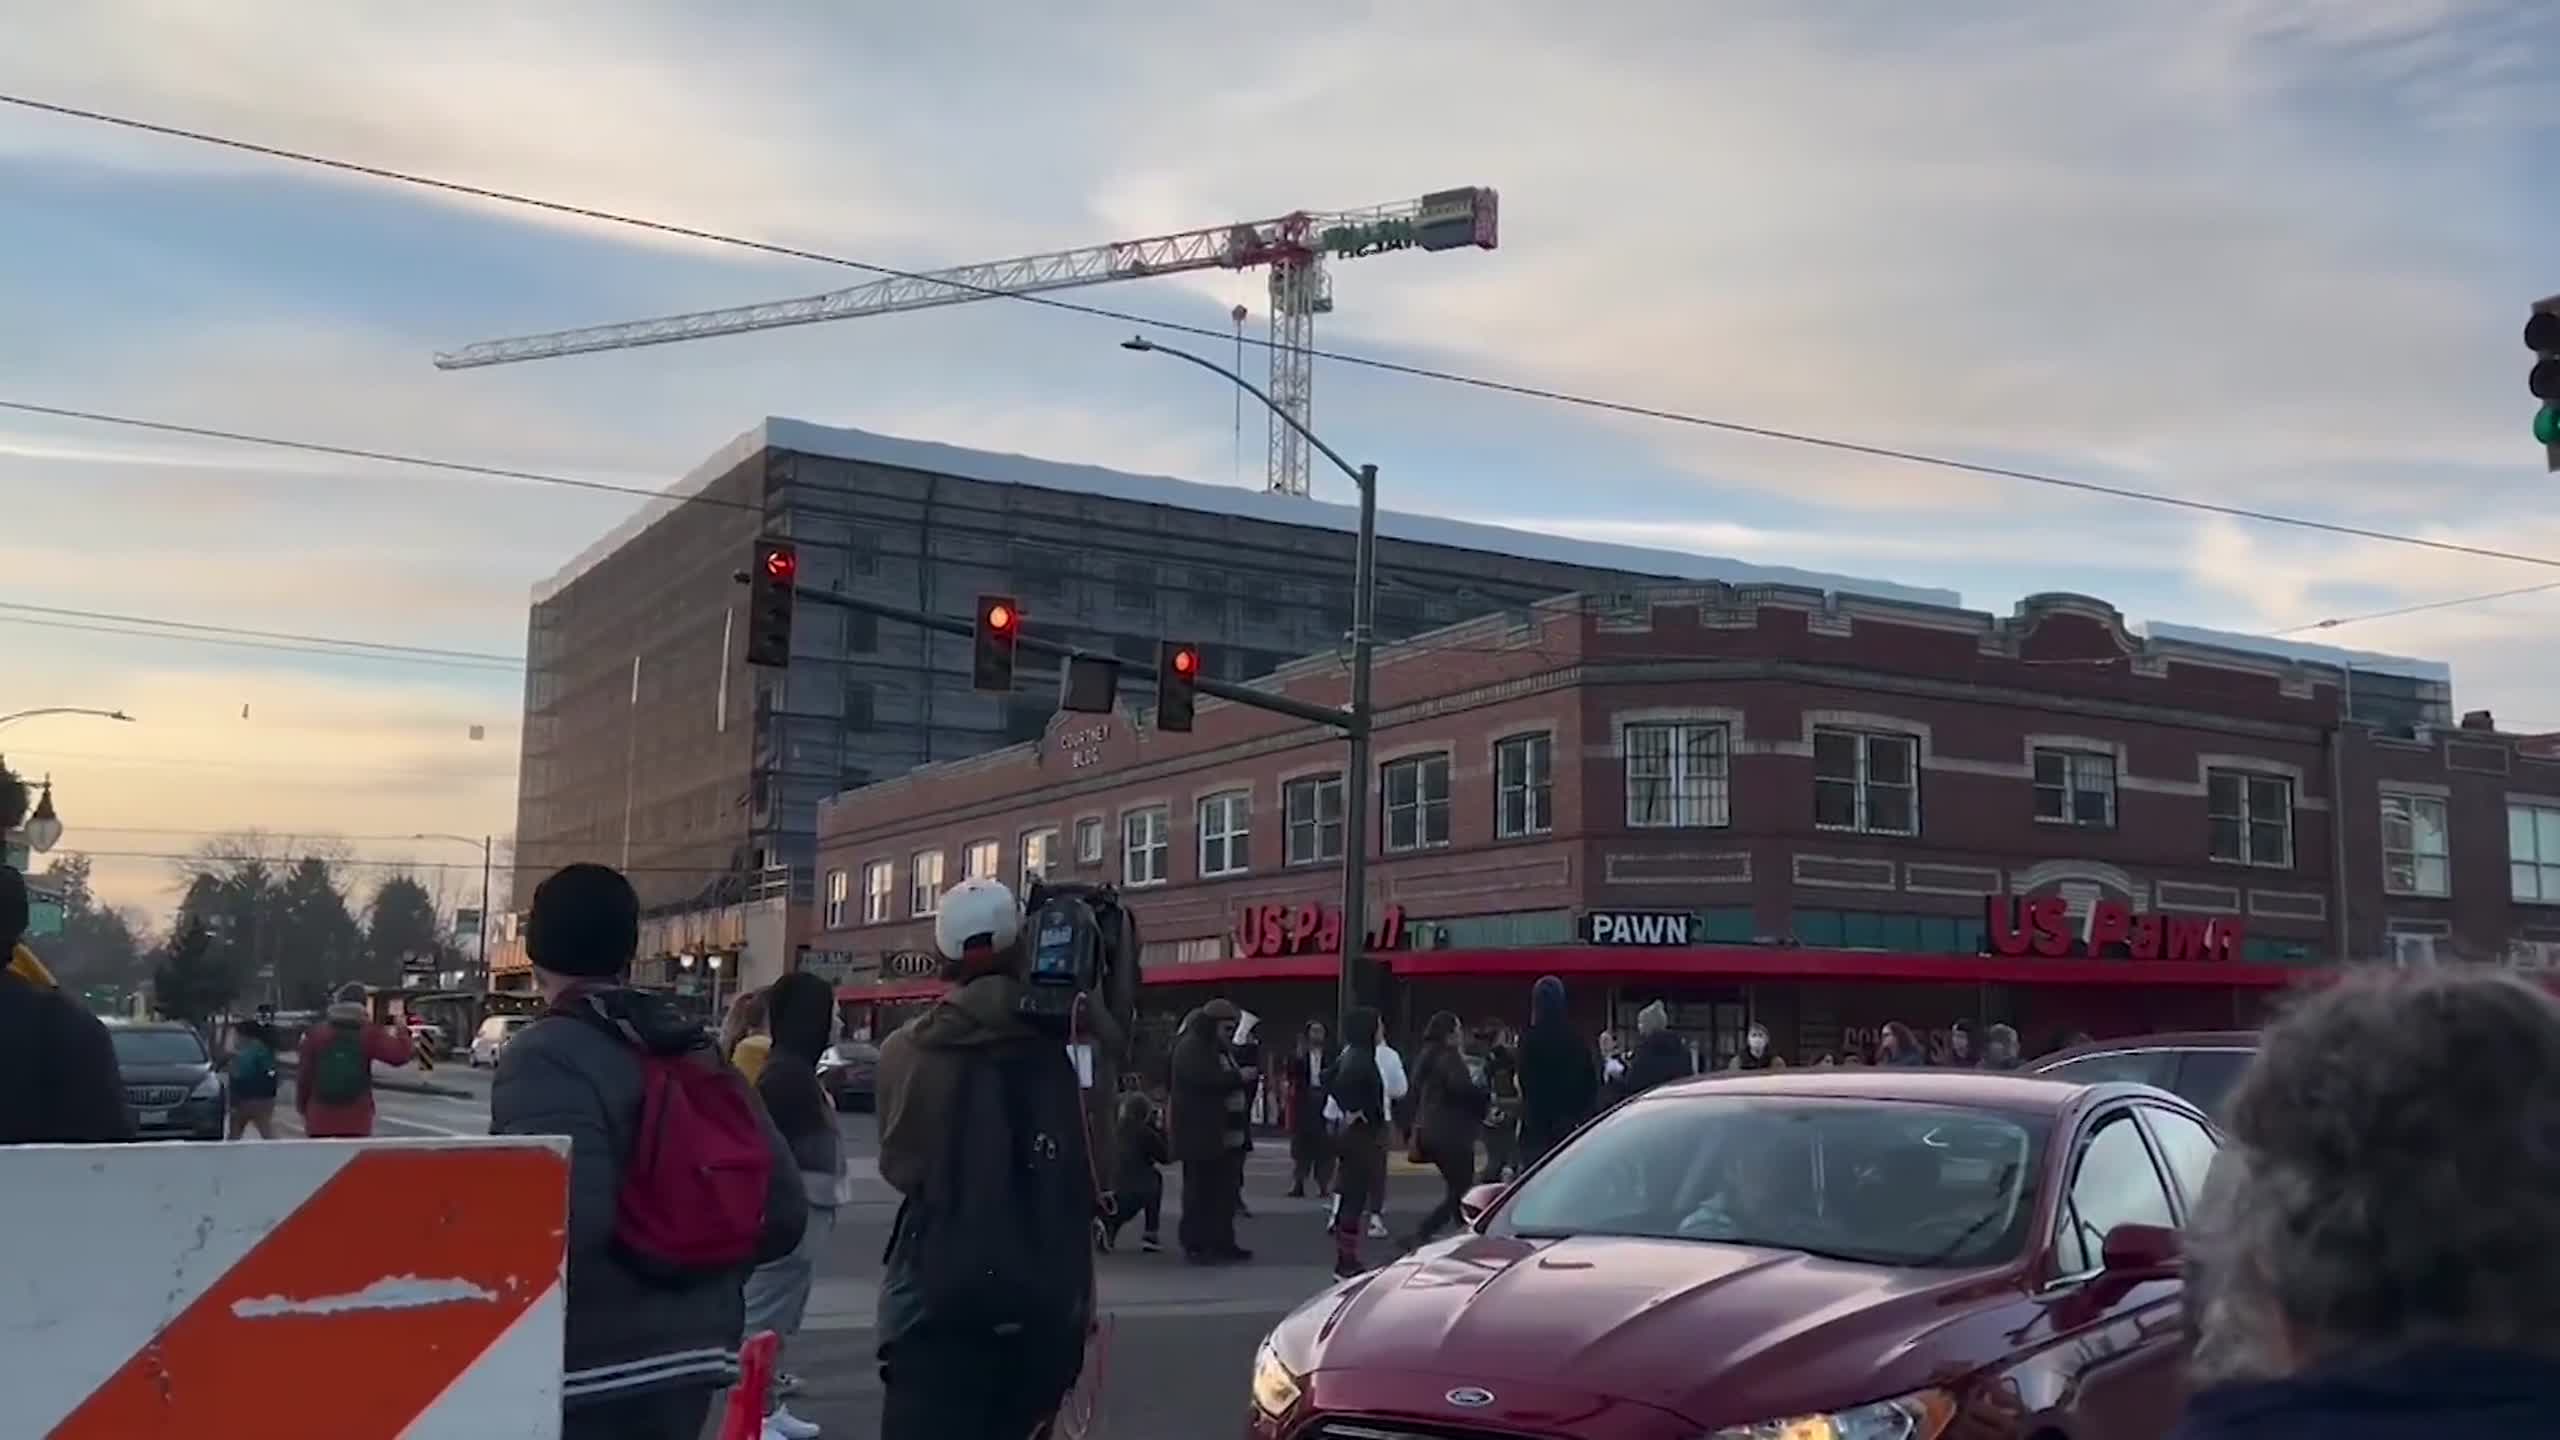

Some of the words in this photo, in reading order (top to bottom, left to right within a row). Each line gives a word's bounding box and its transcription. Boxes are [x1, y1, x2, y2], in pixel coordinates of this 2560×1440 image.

[1239, 904, 1287, 957] US
[1291, 902, 1404, 952] Pan
[1593, 914, 1687, 944] PAWN
[1987, 894, 2074, 958] US
[2084, 898, 2241, 961] Pawn
